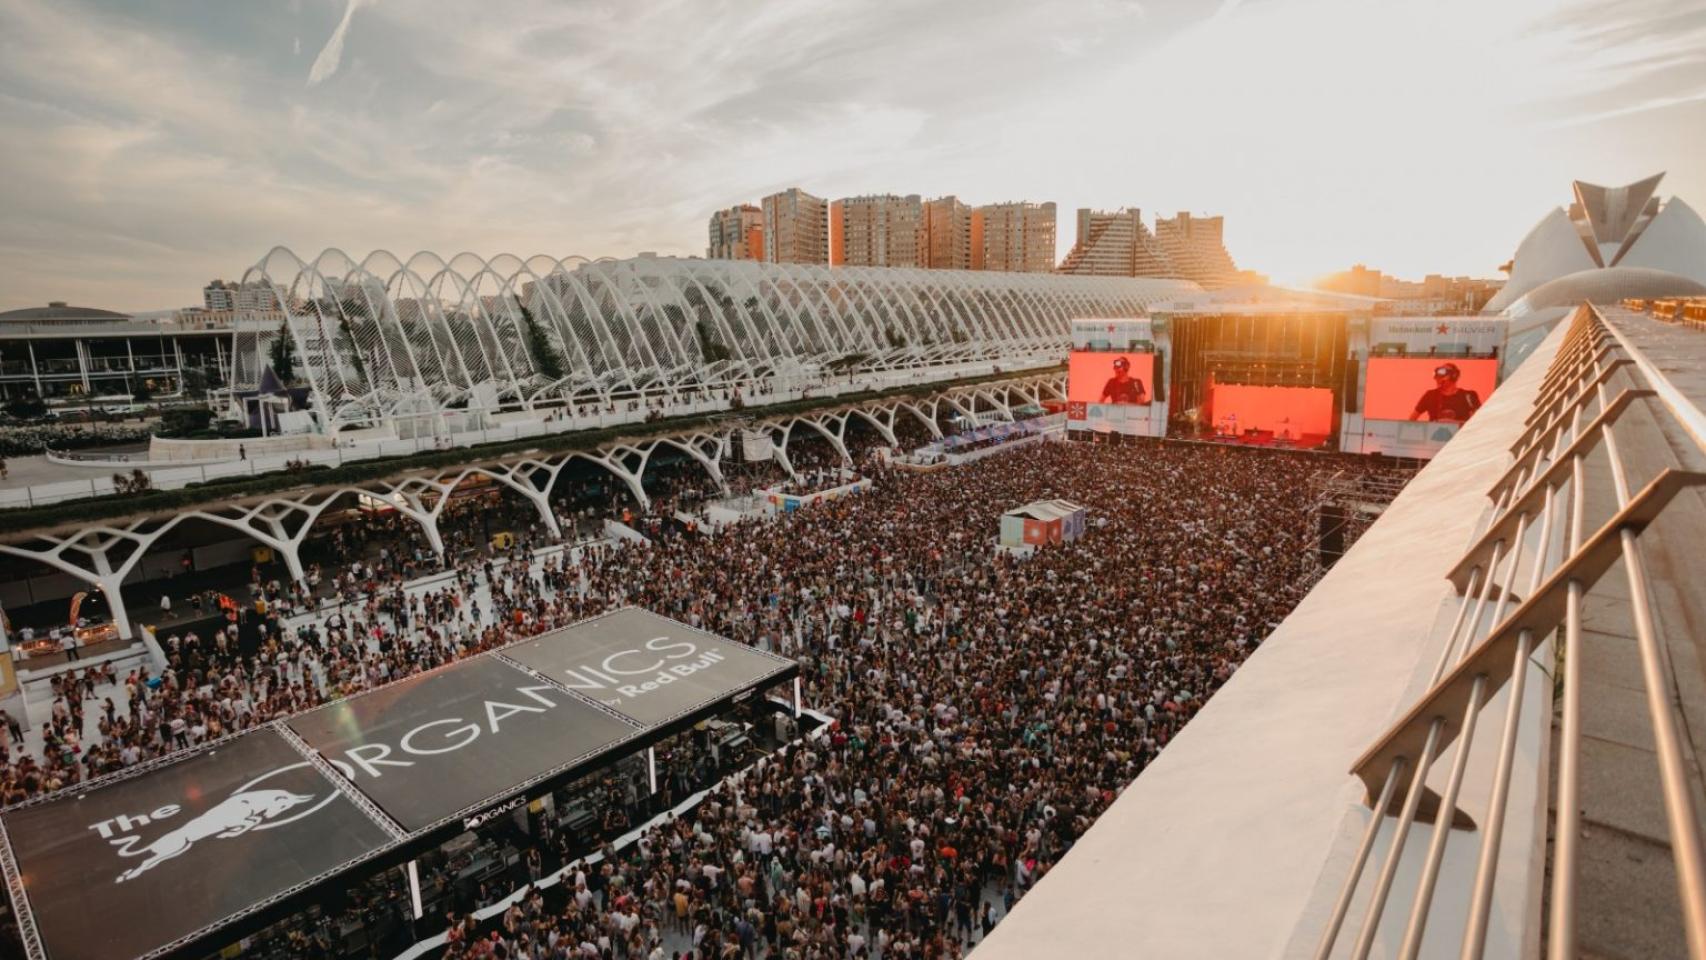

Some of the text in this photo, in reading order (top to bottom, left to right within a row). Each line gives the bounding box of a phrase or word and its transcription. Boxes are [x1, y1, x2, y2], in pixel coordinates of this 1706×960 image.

[616, 671, 678, 697] Red
[669, 651, 725, 676] Bull
[231, 636, 697, 831] ORGANICS
[88, 804, 181, 838] The
[472, 795, 527, 827] ORGANICS
